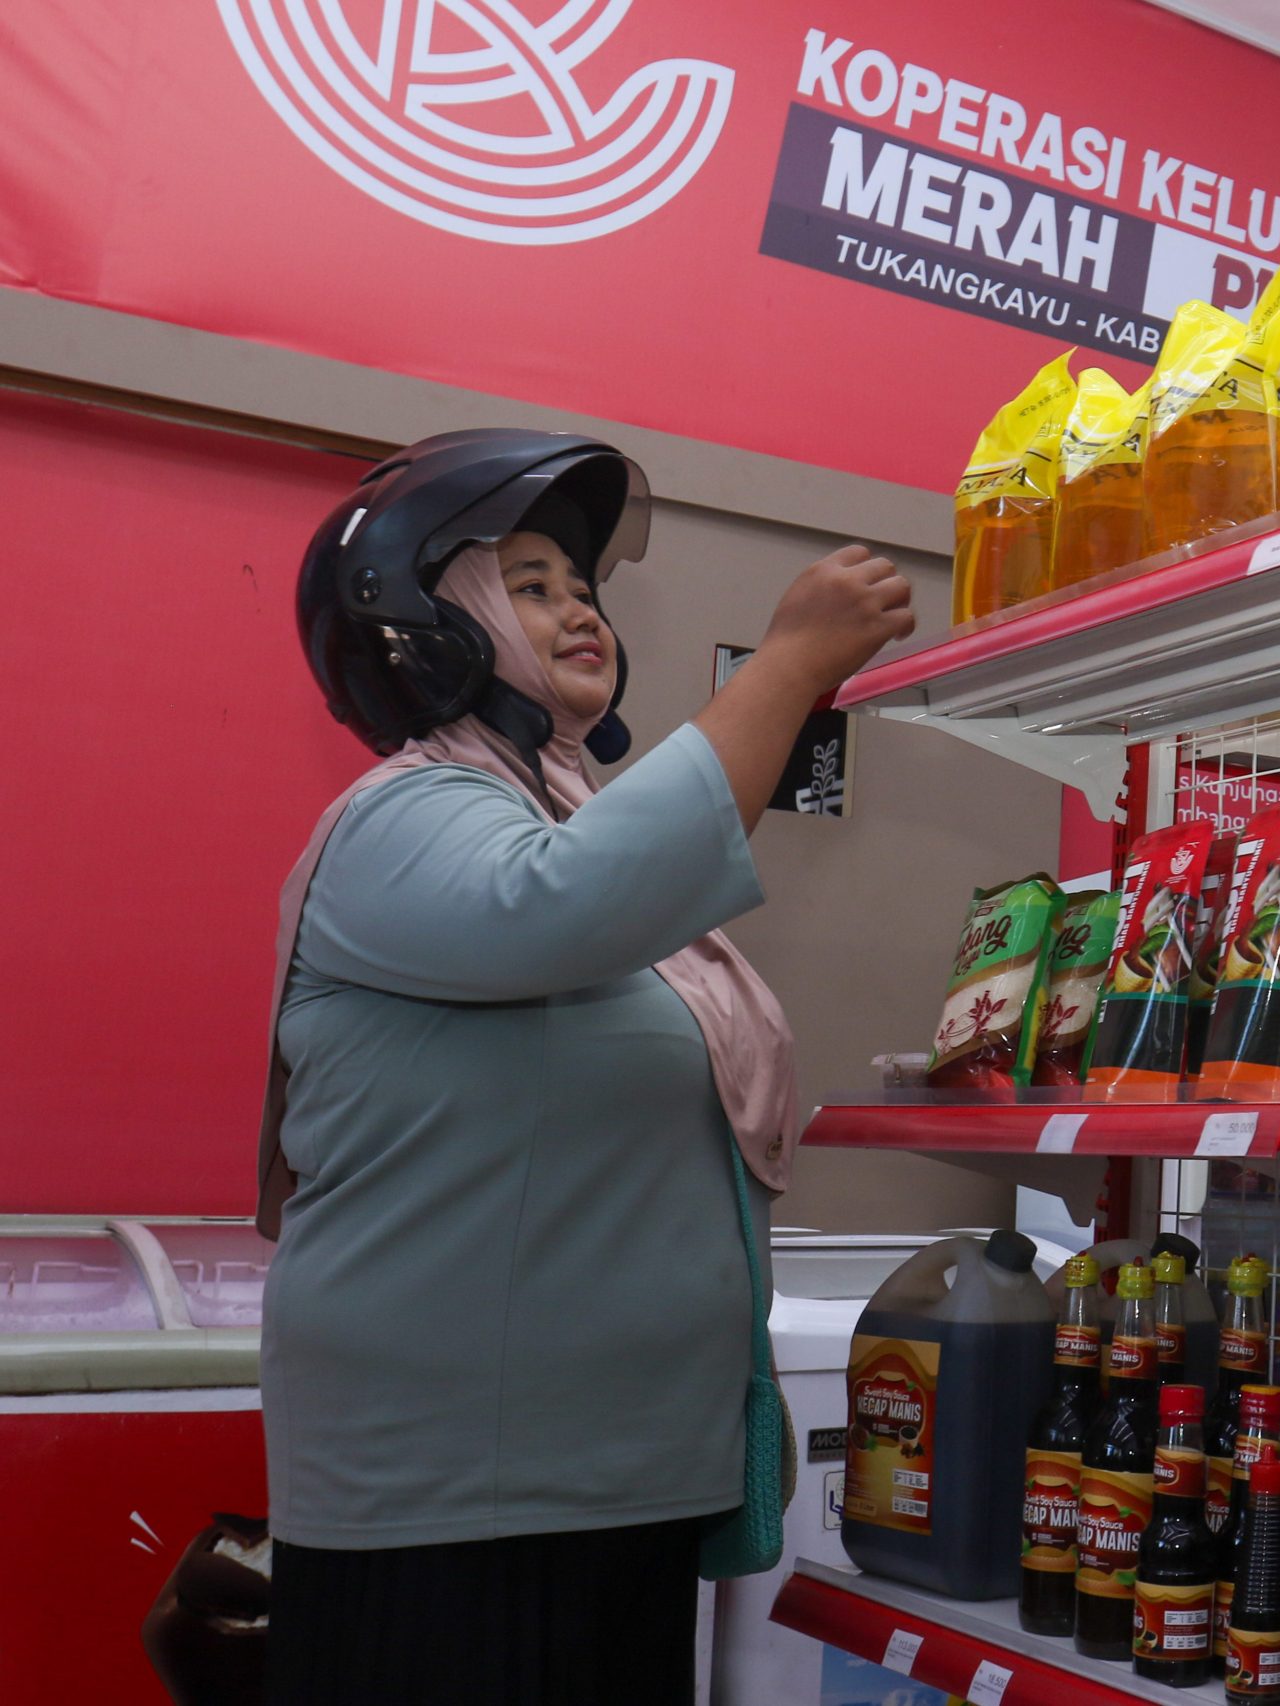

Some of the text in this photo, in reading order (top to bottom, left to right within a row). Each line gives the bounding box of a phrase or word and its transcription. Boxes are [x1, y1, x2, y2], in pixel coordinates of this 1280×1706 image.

[797, 28, 1126, 199] KOPERASI
[821, 126, 1120, 292] MERAH
[836, 235, 1070, 327] TUKANGKAYU
[1094, 312, 1160, 354] KAB
[856, 1396, 922, 1423] KECAP MANIS
[1095, 1530, 1142, 1553] MANIS
